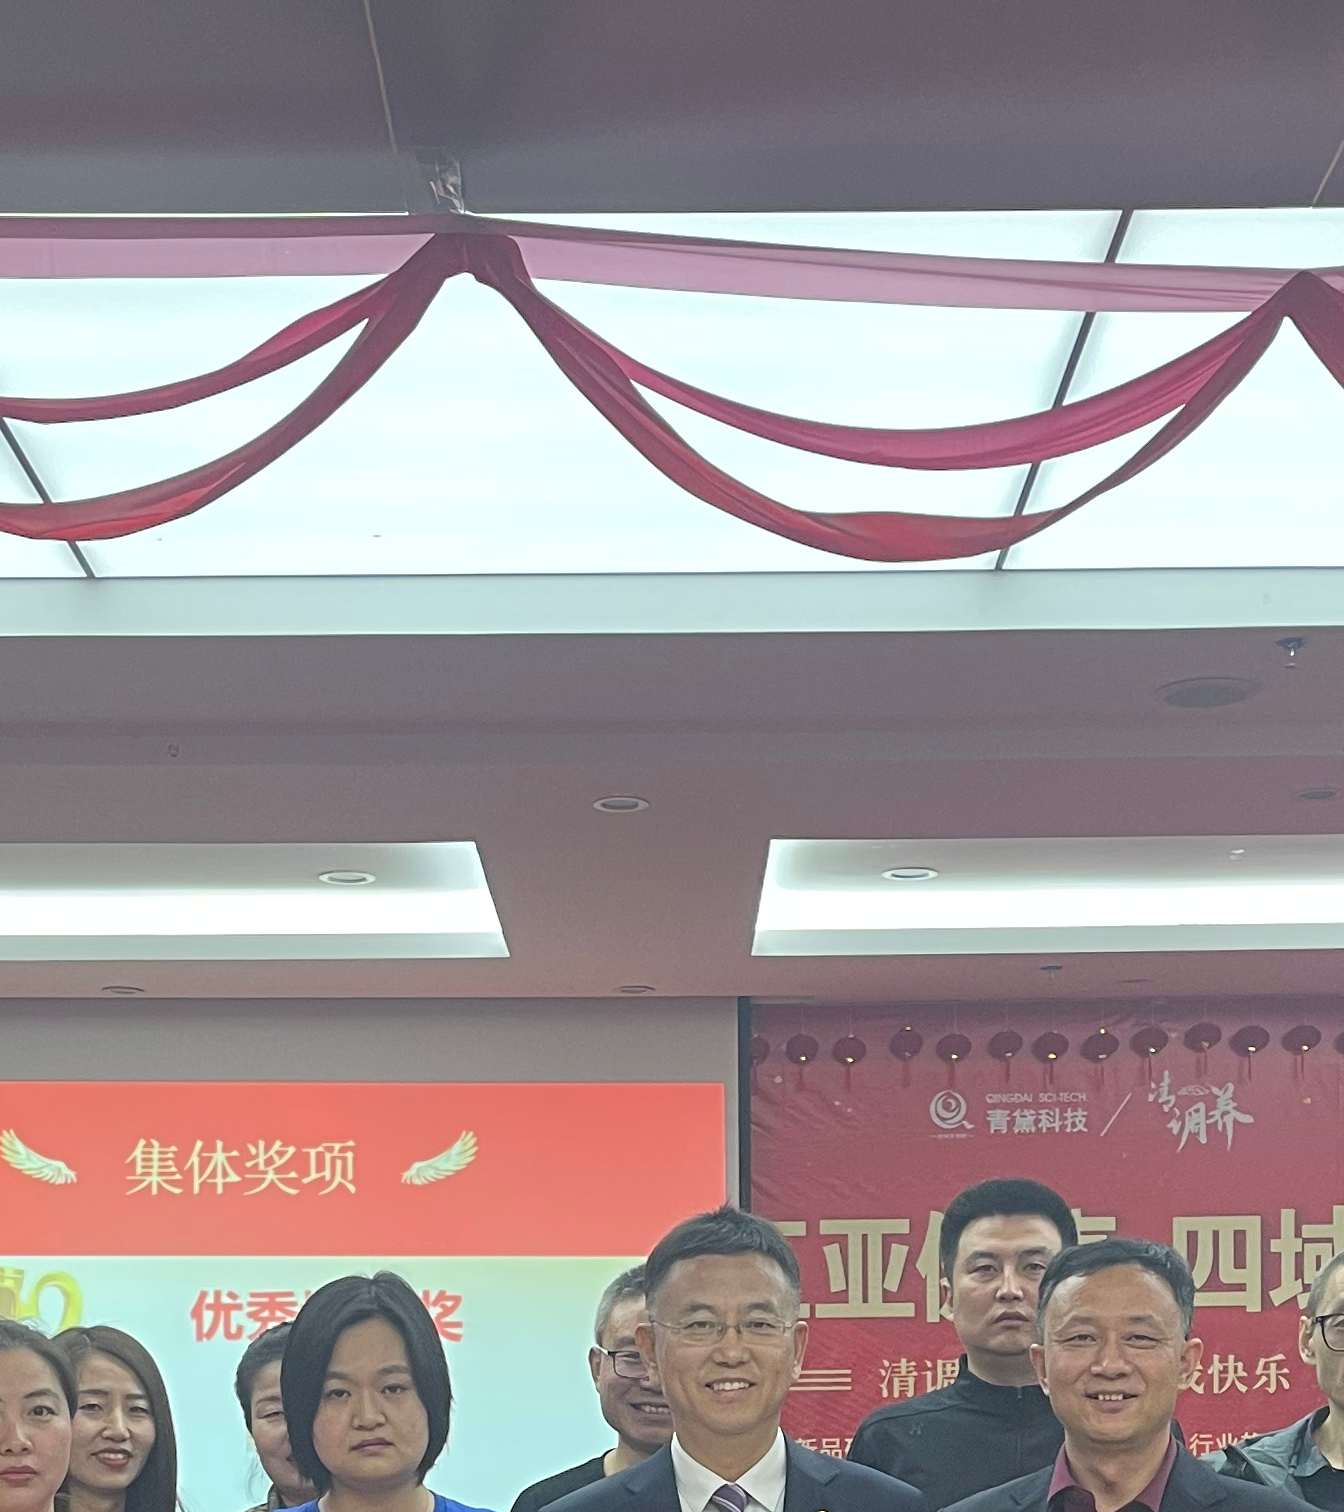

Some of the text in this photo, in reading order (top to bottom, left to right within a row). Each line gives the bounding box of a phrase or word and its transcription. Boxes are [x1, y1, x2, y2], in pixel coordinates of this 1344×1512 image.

[985, 1107, 1088, 1134] 青黛科技
[125, 1138, 357, 1196] 集体奖项
[190, 1290, 464, 1343] 优秀奖
[1189, 1432, 1258, 1457] 行业
